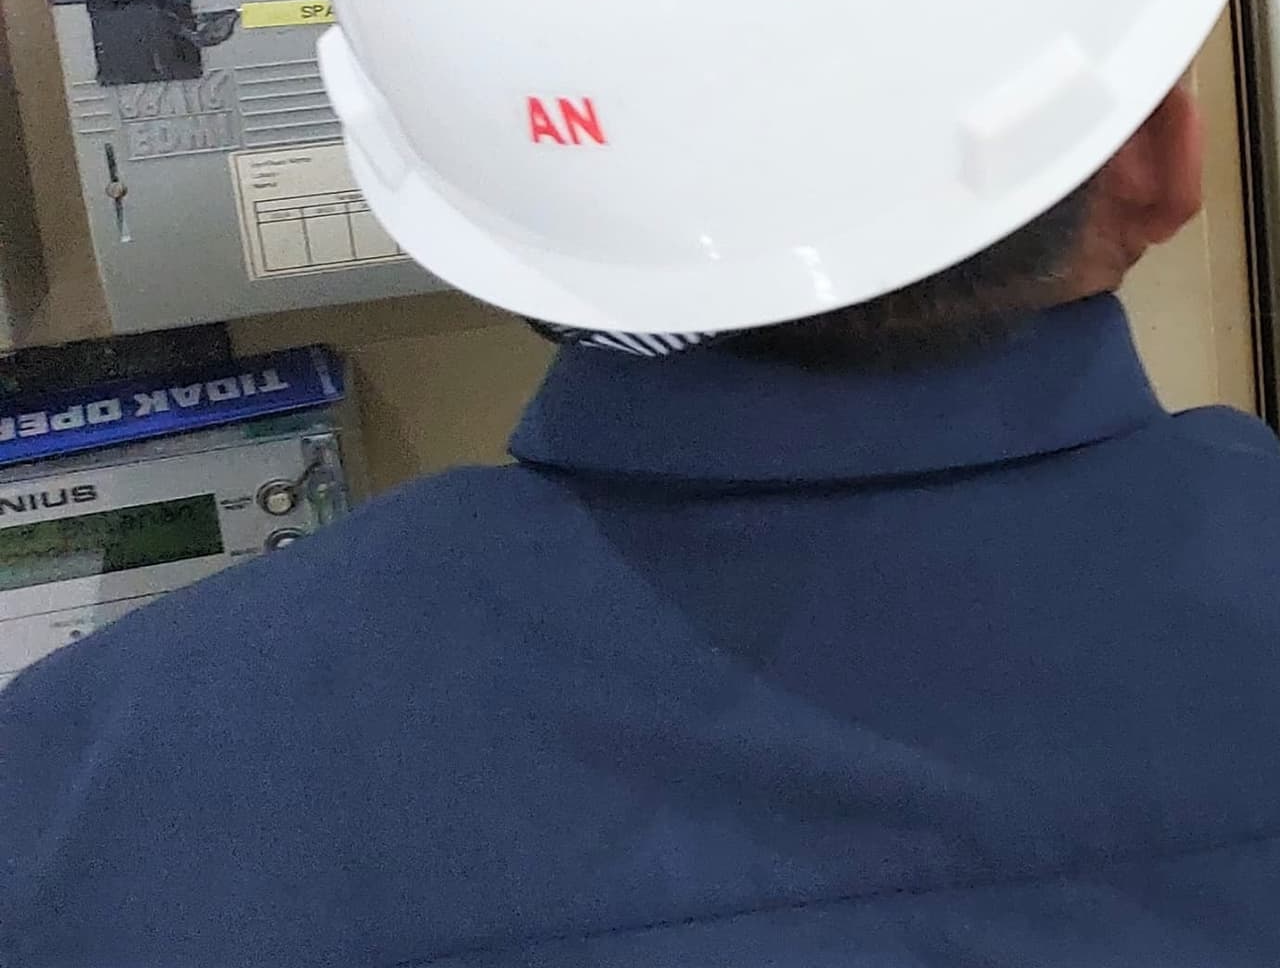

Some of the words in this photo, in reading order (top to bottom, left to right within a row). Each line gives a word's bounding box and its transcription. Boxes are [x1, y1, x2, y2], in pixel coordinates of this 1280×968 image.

[528, 96, 606, 145] AN
[134, 368, 290, 418] TIDAK
[0, 483, 98, 516] NIUS
